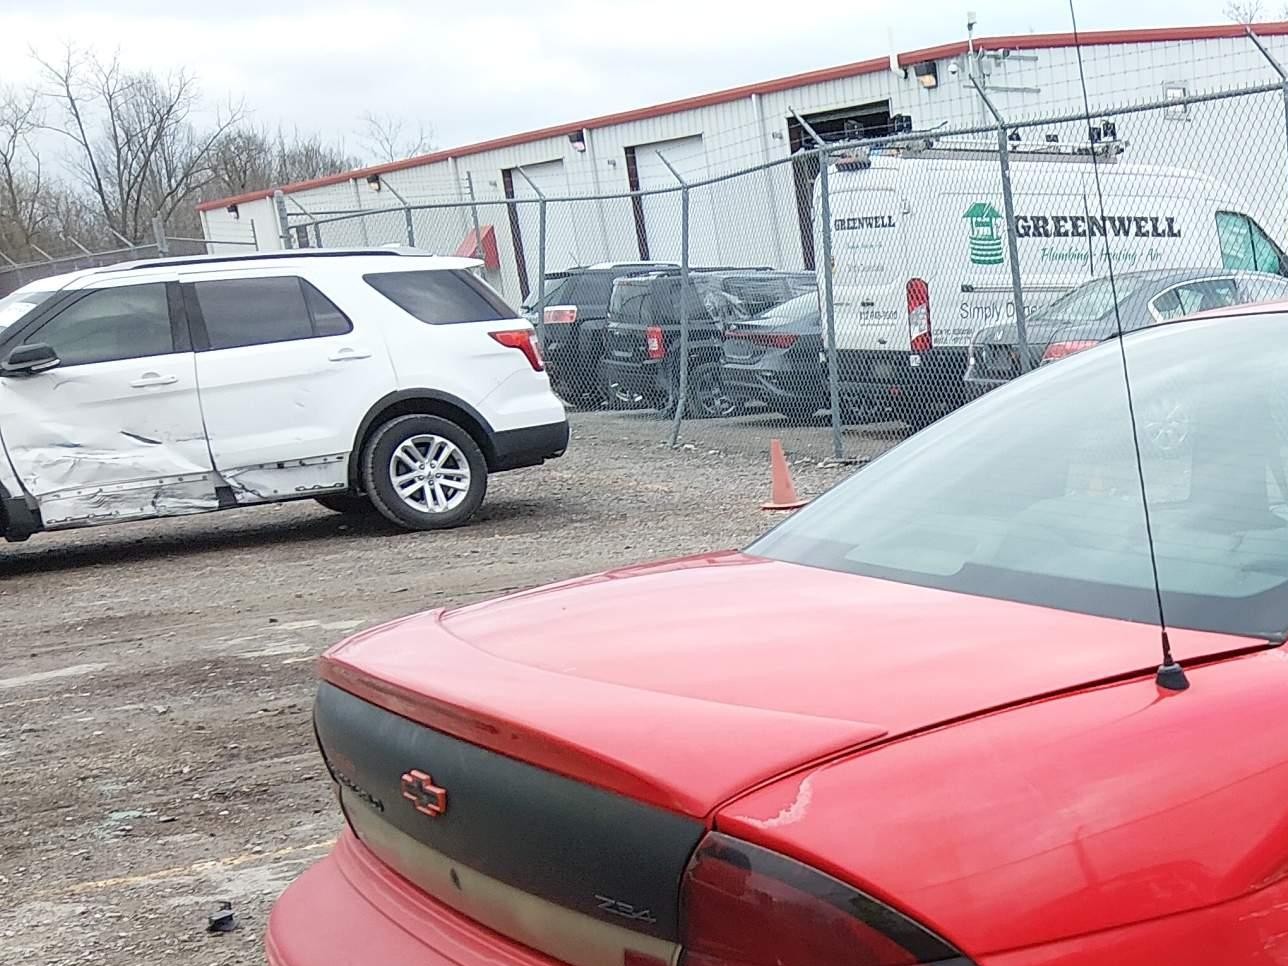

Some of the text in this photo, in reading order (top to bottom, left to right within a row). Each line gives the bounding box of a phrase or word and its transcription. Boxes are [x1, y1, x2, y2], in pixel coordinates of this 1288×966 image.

[834, 216, 896, 231] GREENWELL
[1014, 215, 1181, 238] GREENWELL
[1041, 247, 1089, 265] Plumbing
[960, 302, 1001, 322] Simply
[594, 893, 657, 923] Z34
